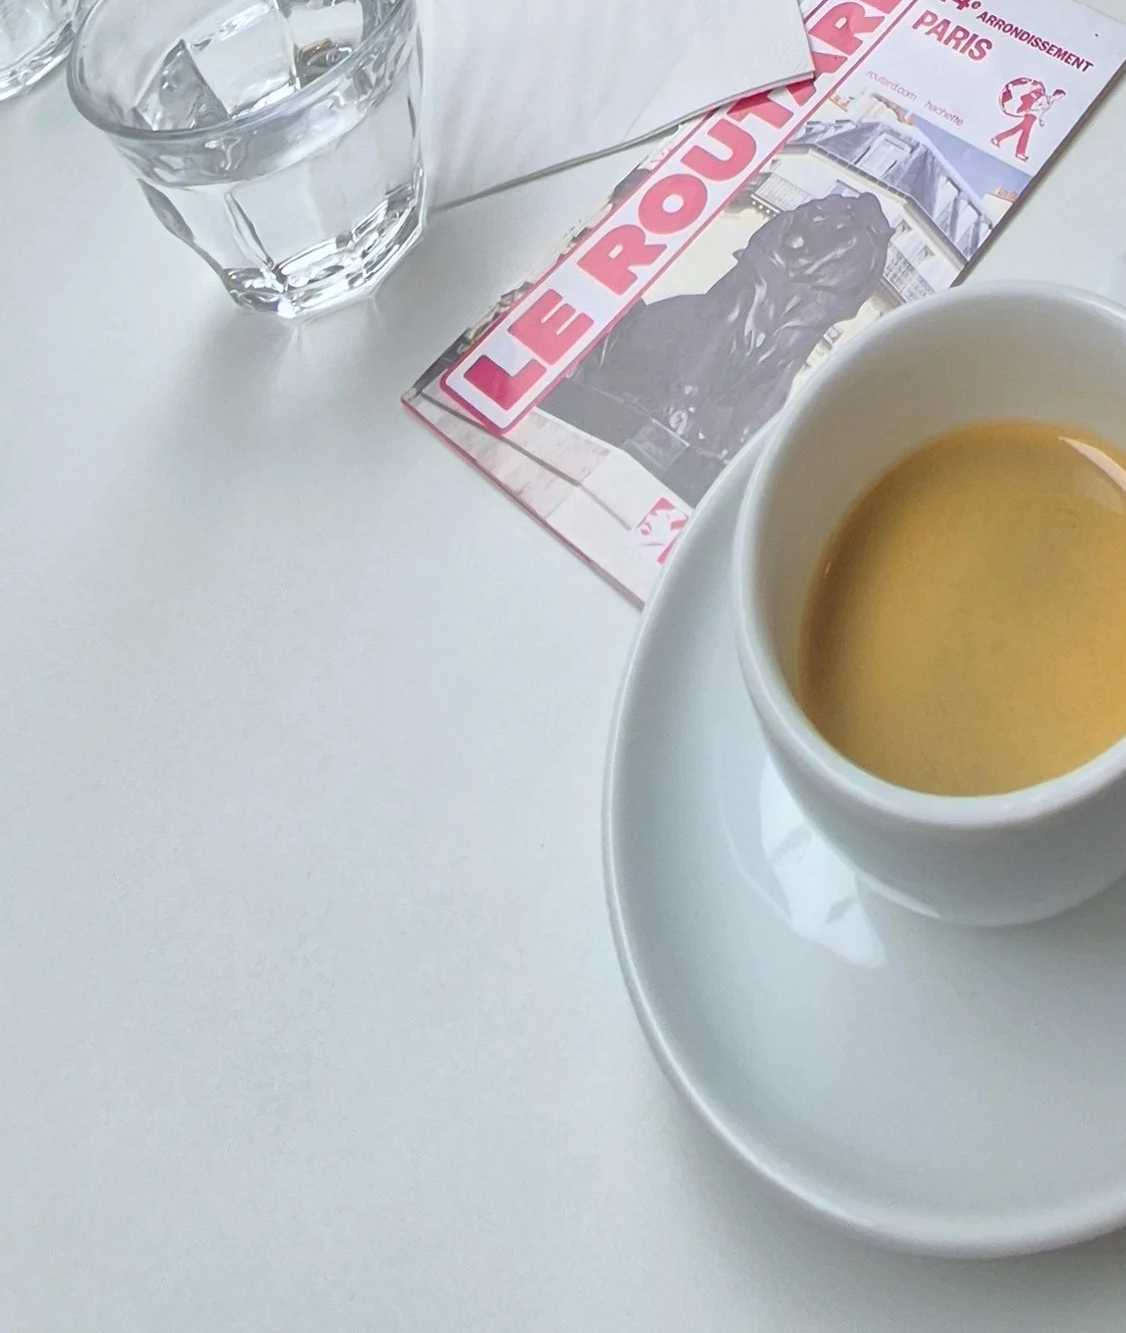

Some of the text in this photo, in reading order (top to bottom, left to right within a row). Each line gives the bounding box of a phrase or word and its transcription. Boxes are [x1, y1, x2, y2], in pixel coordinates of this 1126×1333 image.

[911, 9, 993, 62] PARIS
[976, 11, 1094, 73] ARRONDISSEMENT
[463, 288, 595, 411] LE
